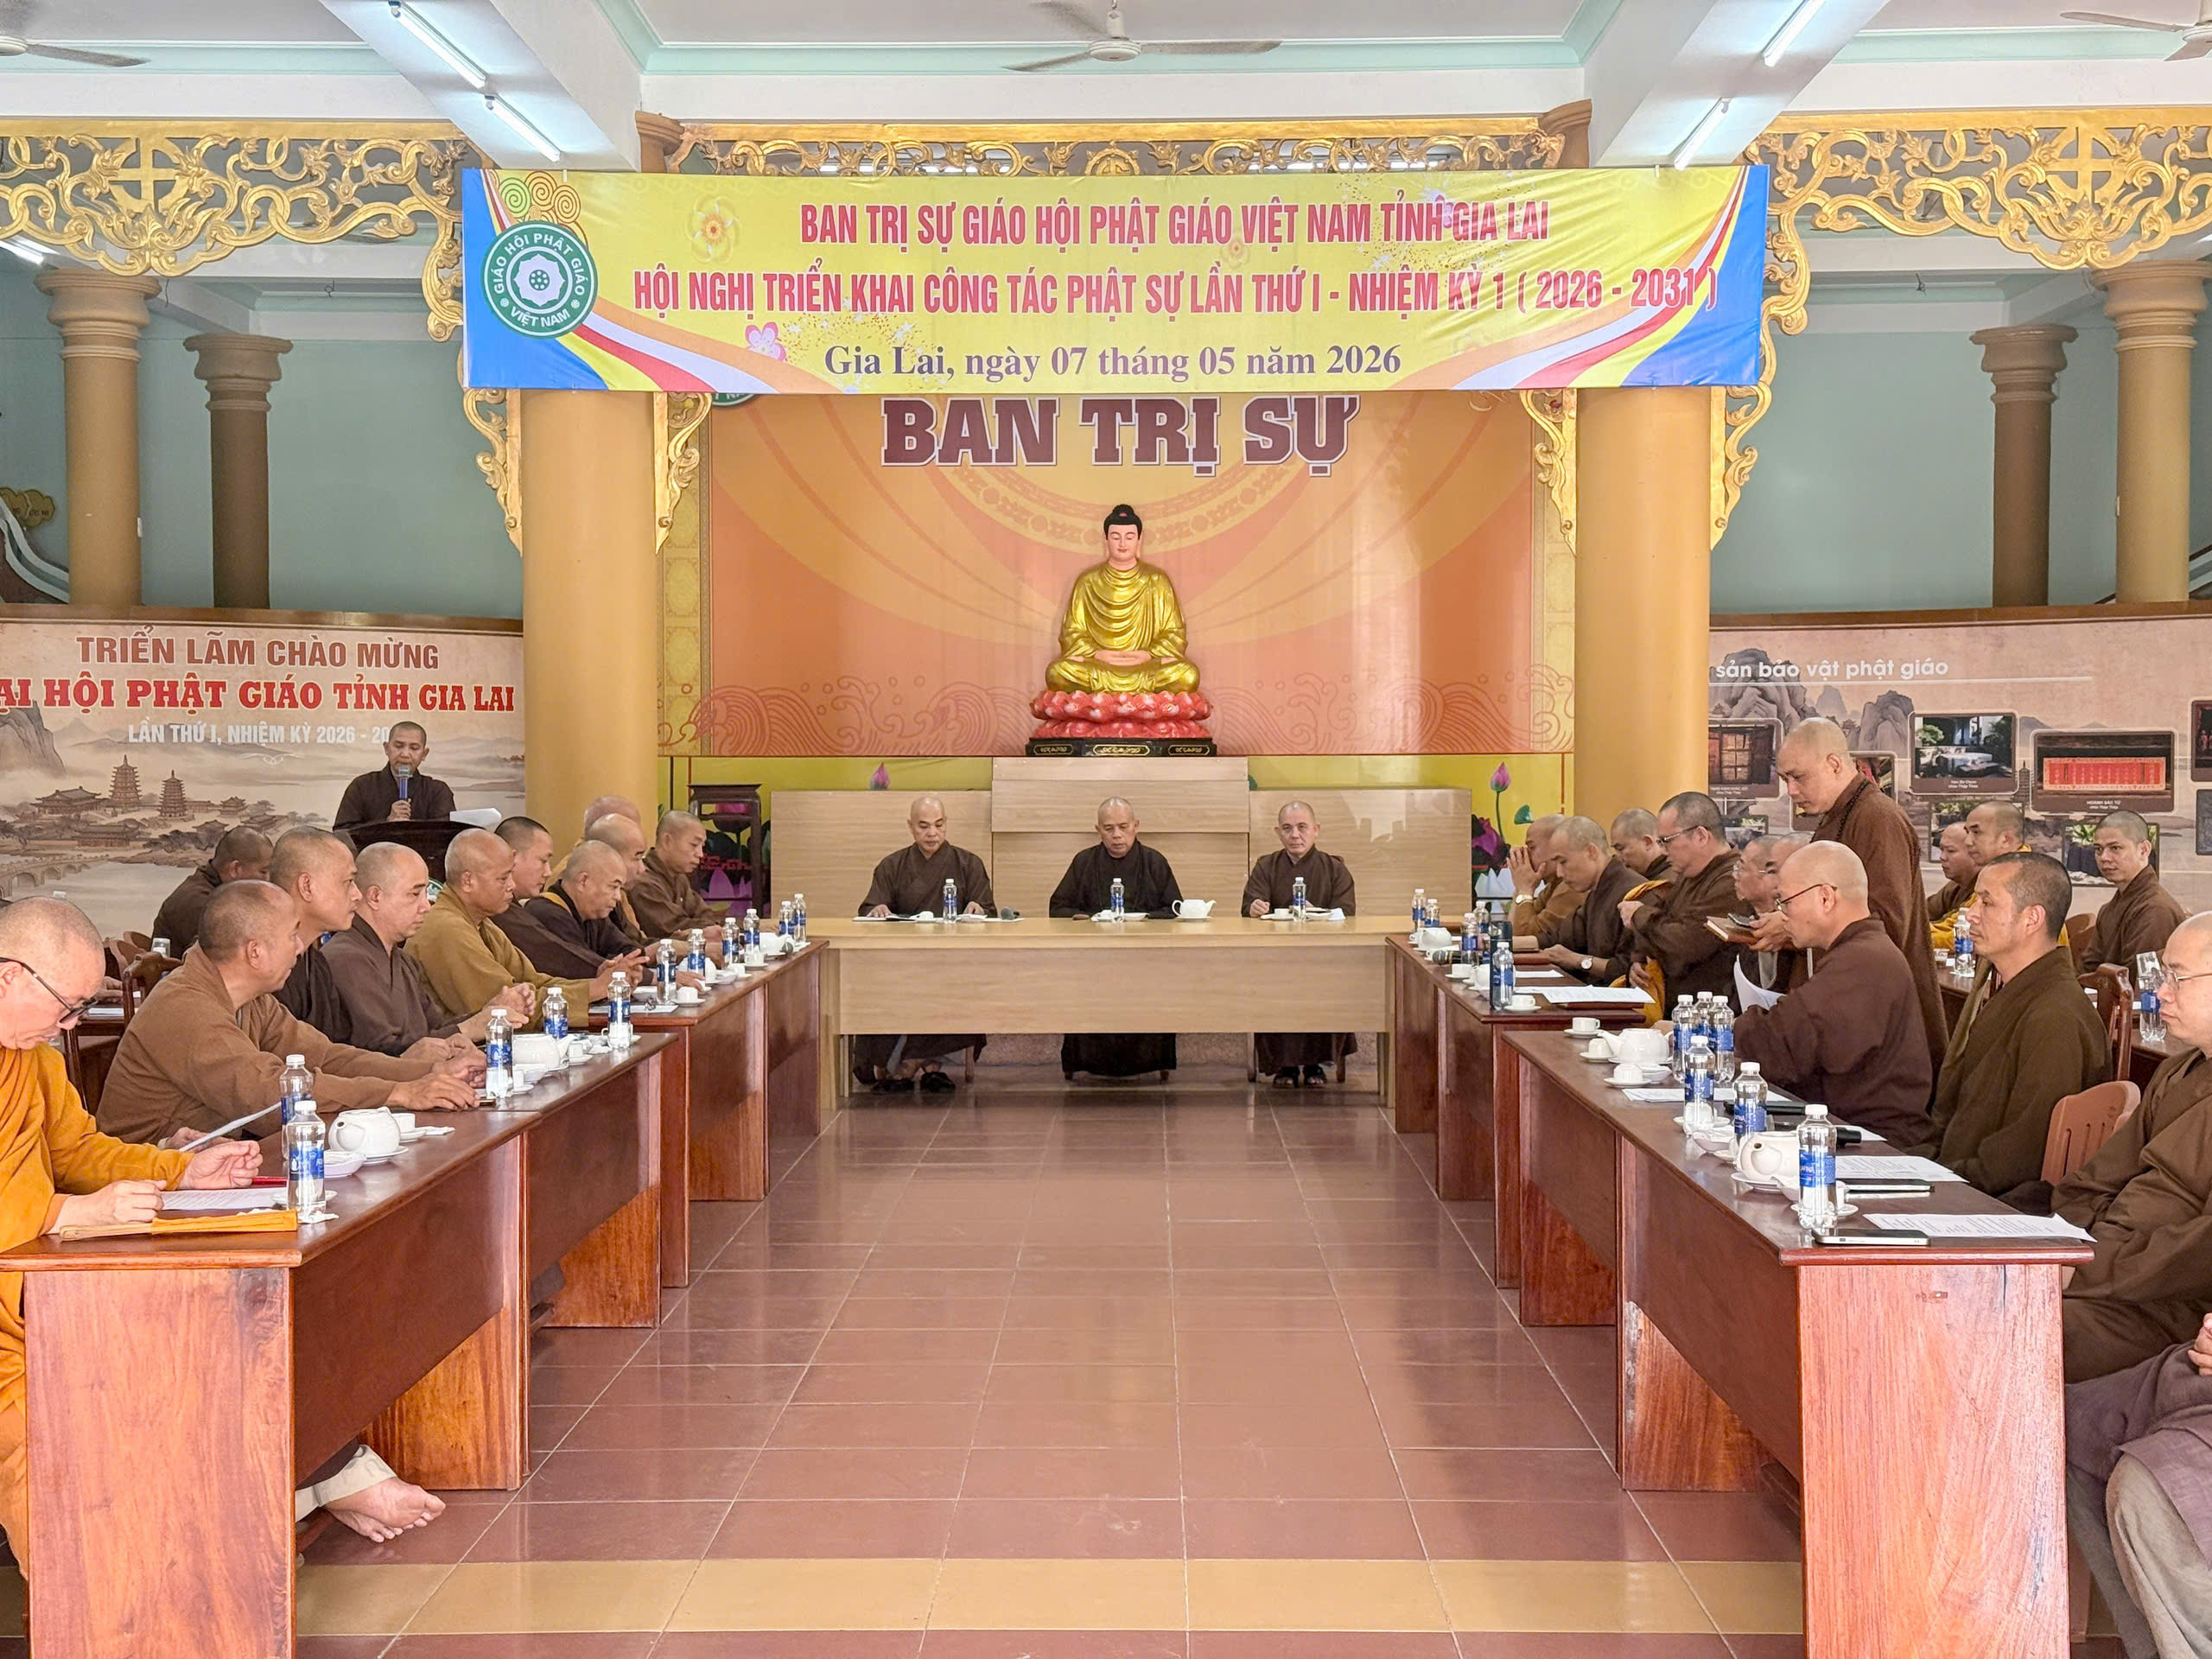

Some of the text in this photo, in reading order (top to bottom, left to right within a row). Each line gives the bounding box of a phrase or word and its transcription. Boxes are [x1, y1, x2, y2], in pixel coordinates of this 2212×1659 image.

[800, 188, 1549, 253] BAN TRỊ SỰ GIÁO HỘI PHẬT GIÁO VIỆT NAM TỈNH GIA LAI
[490, 232, 588, 296] GIÁO HỘI PHẬT GIÁO
[633, 263, 679, 319] HỘI
[688, 271, 754, 321] NGHỊ
[762, 257, 842, 313] TRIỂN
[850, 273, 914, 313] KHAI
[923, 265, 999, 314] CÔNG
[1006, 265, 1058, 314] TÁC
[1066, 265, 1137, 322] PHẬT
[1145, 270, 1185, 322] SỰ
[1190, 260, 1243, 314] LẦN
[1250, 264, 1306, 313] THỨ
[1312, 273, 1320, 312] I
[1329, 290, 1340, 300] -
[1348, 264, 1439, 320] NHIỆM
[1447, 263, 1484, 311] KỲ
[1492, 271, 1504, 310] 1
[1535, 270, 1603, 310] 2026
[1611, 286, 1623, 296] -
[1630, 267, 1695, 308] 2031
[510, 305, 571, 327] VIỆT NAM
[824, 343, 1402, 384] Gia Lai, ngày 07 tháng 05 năm 2026
[880, 395, 1361, 477] BAN TRỊ SỰ
[76, 624, 439, 670] TRIỂN LÃM CHÀO MỪNG
[1715, 658, 1949, 681] sản bảo vật phật giáo
[0, 671, 515, 715] ẠI HỘI PHẬT GIÁO TỈNH GIA LAI
[128, 716, 165, 743] LẦN
[169, 720, 207, 743] THỨ
[227, 720, 285, 747] NHIỆM
[289, 721, 312, 744] KỲ
[316, 726, 356, 744] 2026
[372, 726, 390, 744] 20
